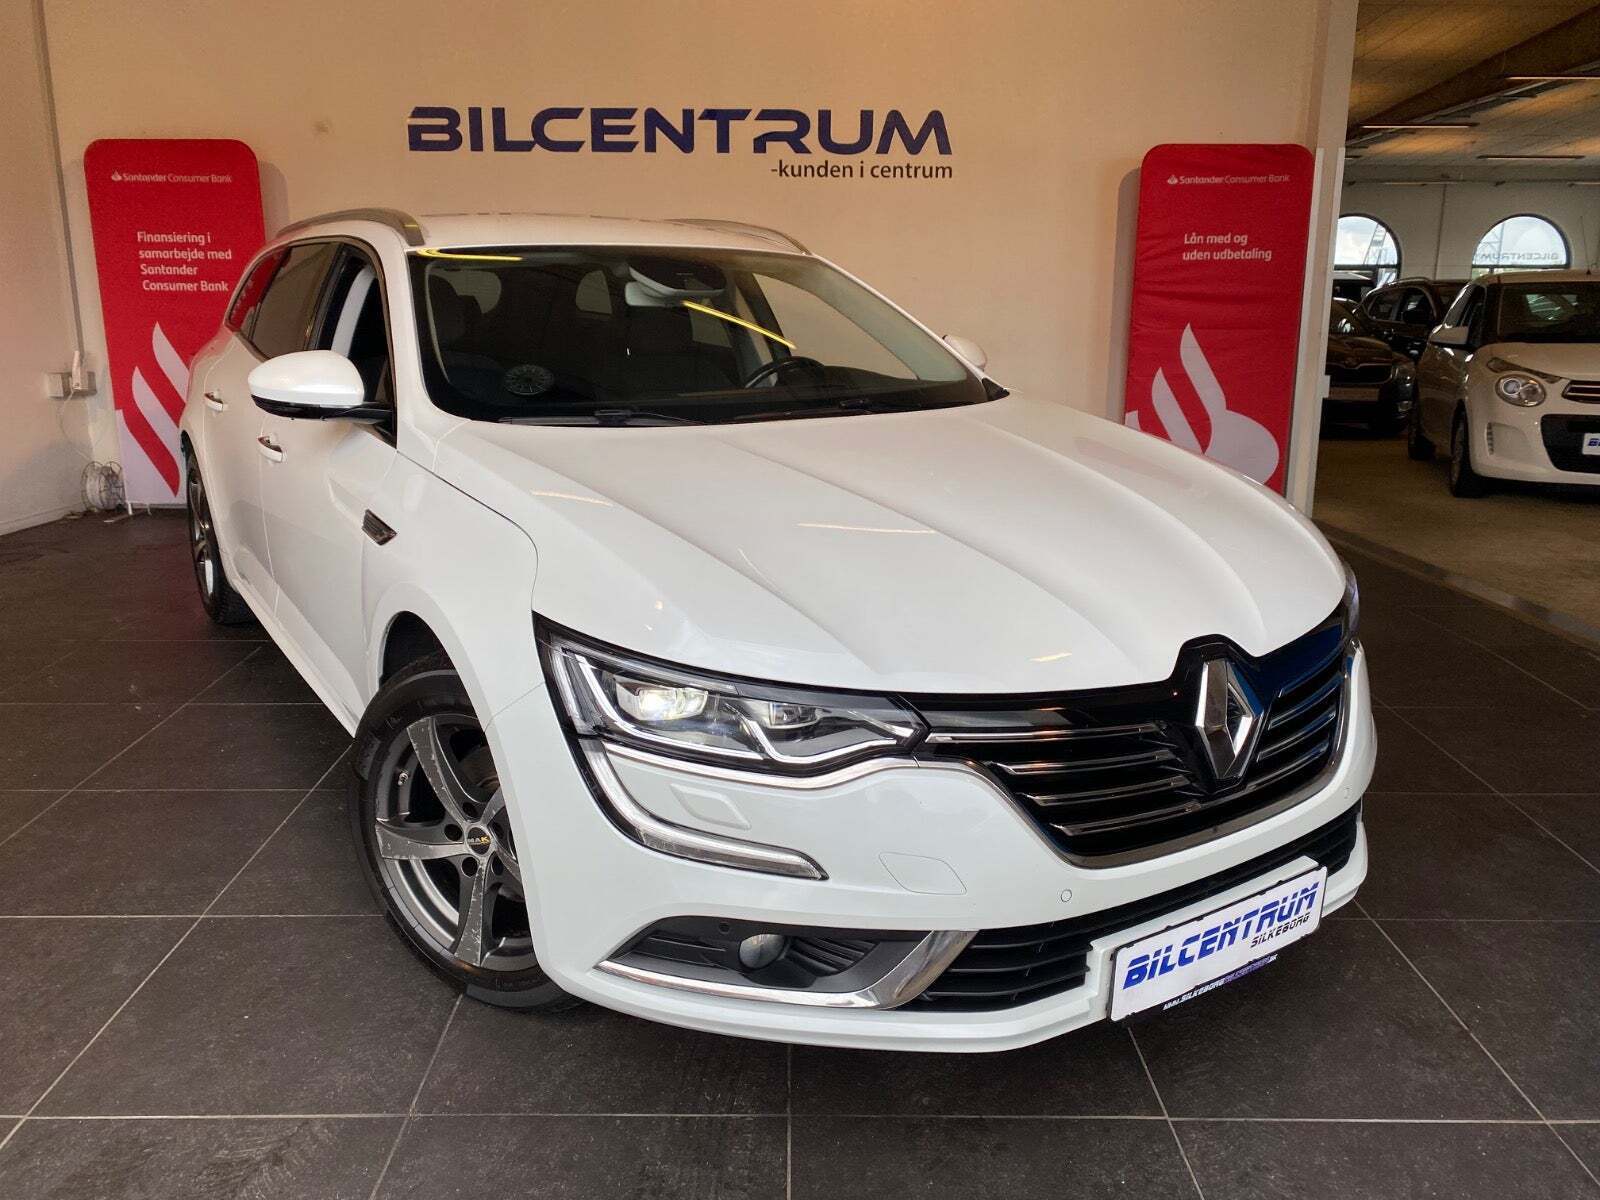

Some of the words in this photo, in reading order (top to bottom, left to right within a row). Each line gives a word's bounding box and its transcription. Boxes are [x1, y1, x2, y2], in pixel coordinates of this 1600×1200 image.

[408, 106, 953, 155] BILCENTRUM
[771, 161, 855, 180] -kunden
[859, 160, 866, 179] i
[870, 163, 954, 180] centrum
[123, 173, 167, 182] Santander
[168, 173, 210, 183] Consumer
[211, 174, 232, 183] Bank
[1179, 175, 1224, 185] Santander
[1225, 175, 1267, 184] Consumer
[1268, 174, 1290, 183] Bank
[137, 231, 205, 245] Finansiering
[207, 232, 211, 243] i
[1184, 232, 1204, 245] Lån
[1206, 233, 1231, 244] med
[1233, 234, 1248, 246] og
[139, 249, 205, 261] samarbejde
[207, 249, 232, 260] med
[1182, 250, 1211, 261] uden
[1212, 248, 1272, 262] udbetaling
[140, 264, 198, 275] Santander
[142, 280, 198, 292] Consumer
[200, 280, 229, 292] Bank
[1122, 882, 1319, 990] BILCENTRUM
[1249, 912, 1311, 949] SILKEBORG
